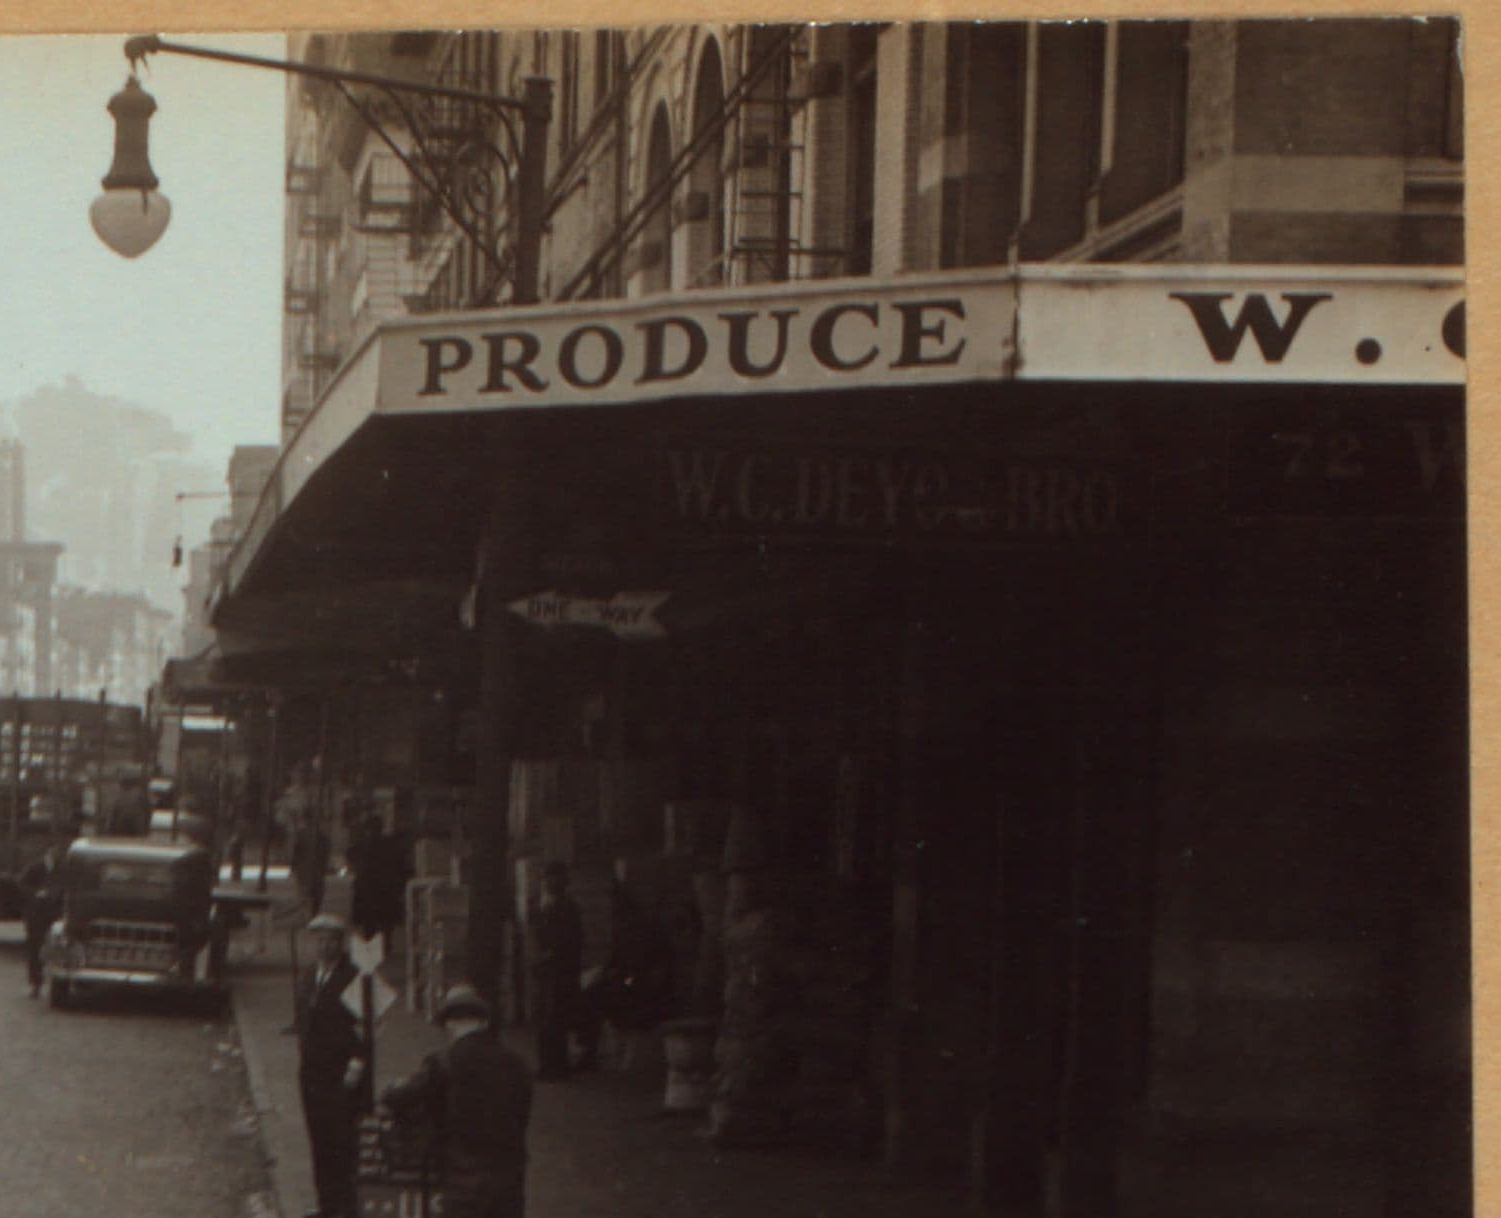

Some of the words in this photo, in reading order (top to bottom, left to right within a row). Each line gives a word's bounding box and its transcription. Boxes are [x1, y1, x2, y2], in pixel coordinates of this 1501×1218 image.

[418, 298, 967, 396] PRODUCE
[1279, 431, 1365, 482] 72
[528, 600, 568, 622] ONE
[601, 603, 645, 625] WAY
